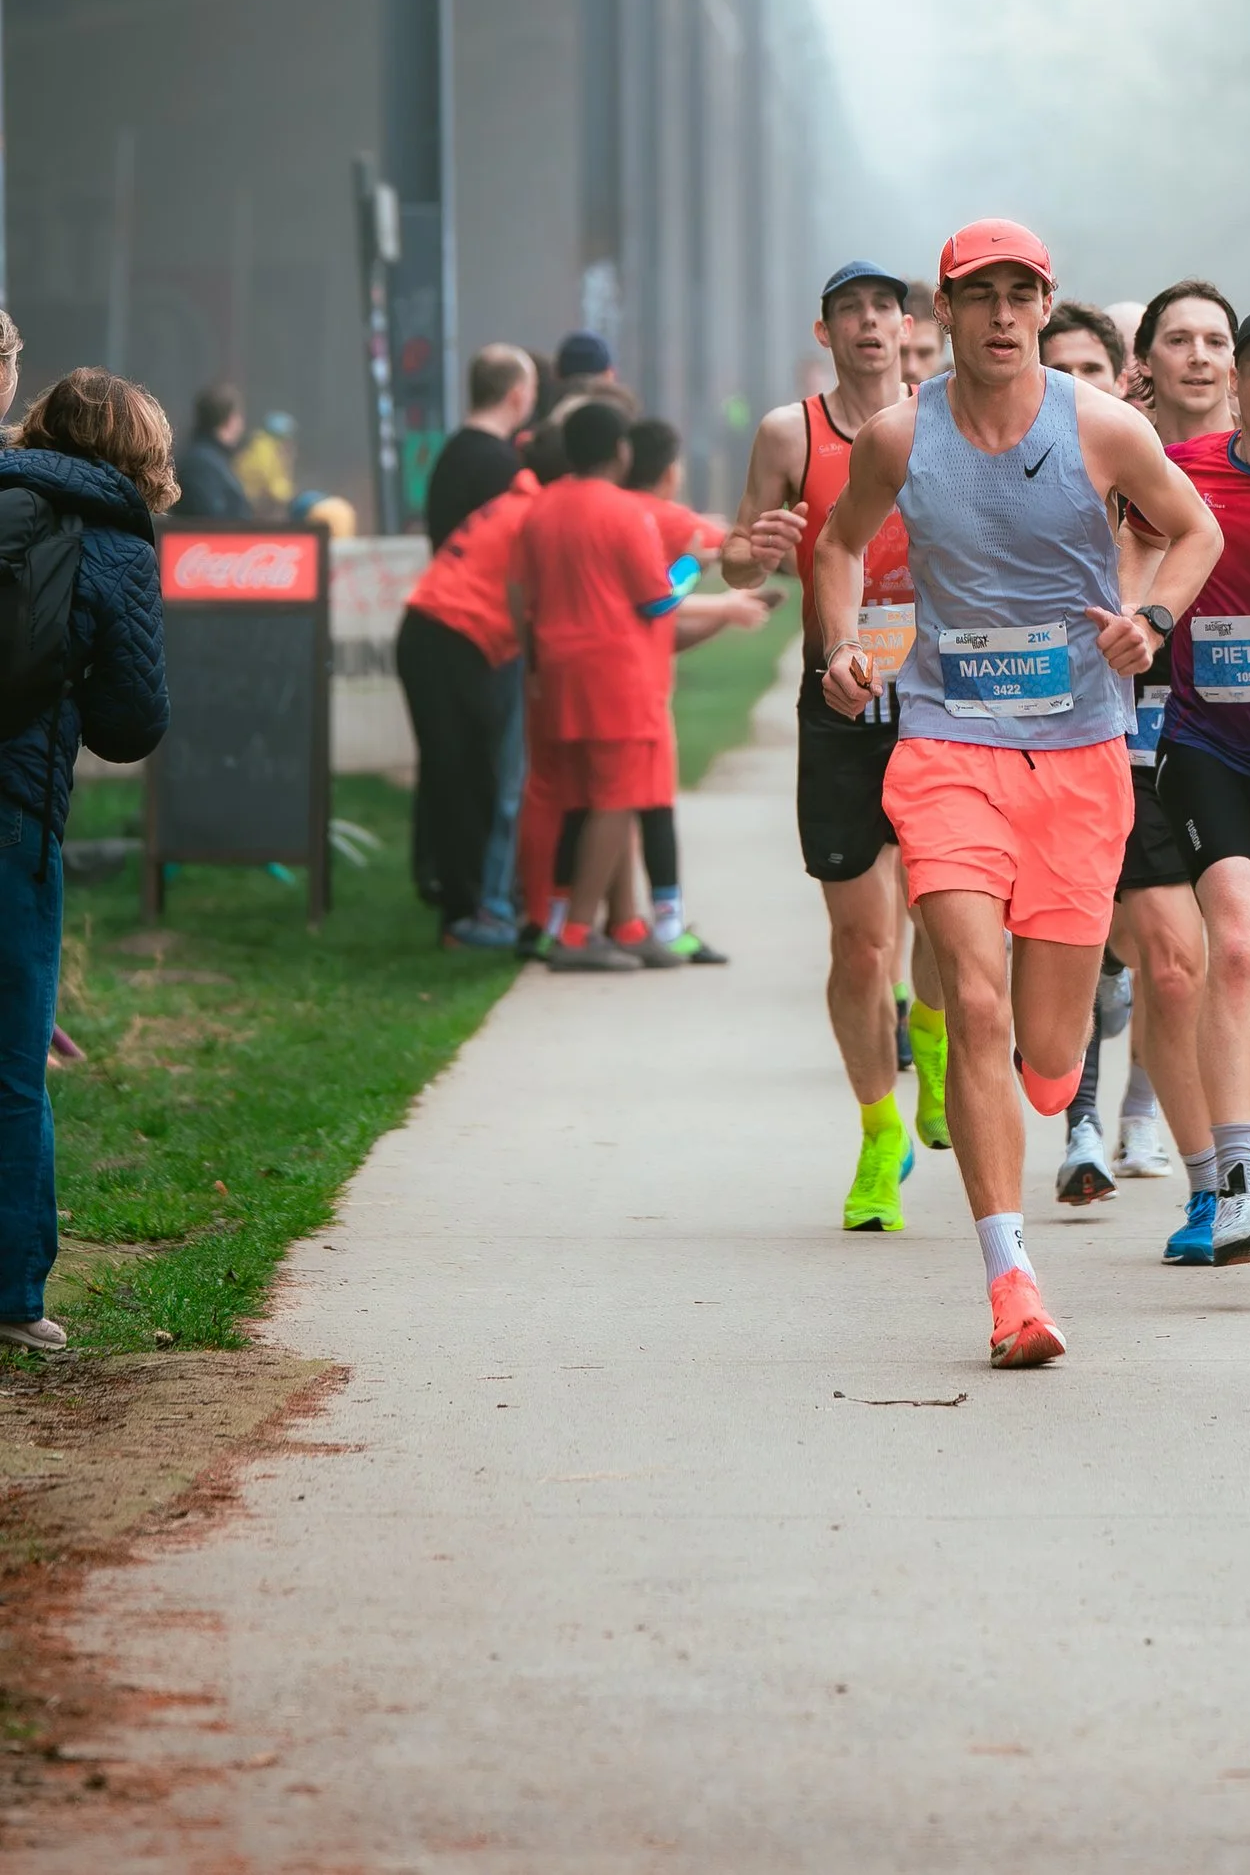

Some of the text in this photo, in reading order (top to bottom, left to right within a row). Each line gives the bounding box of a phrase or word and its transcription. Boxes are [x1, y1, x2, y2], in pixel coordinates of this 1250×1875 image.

[861, 633, 904, 651] SAM
[1027, 631, 1051, 644] 21K
[959, 656, 1051, 678] MAXIME
[992, 684, 1021, 696] 3422
[1185, 819, 1202, 851] FUSION
